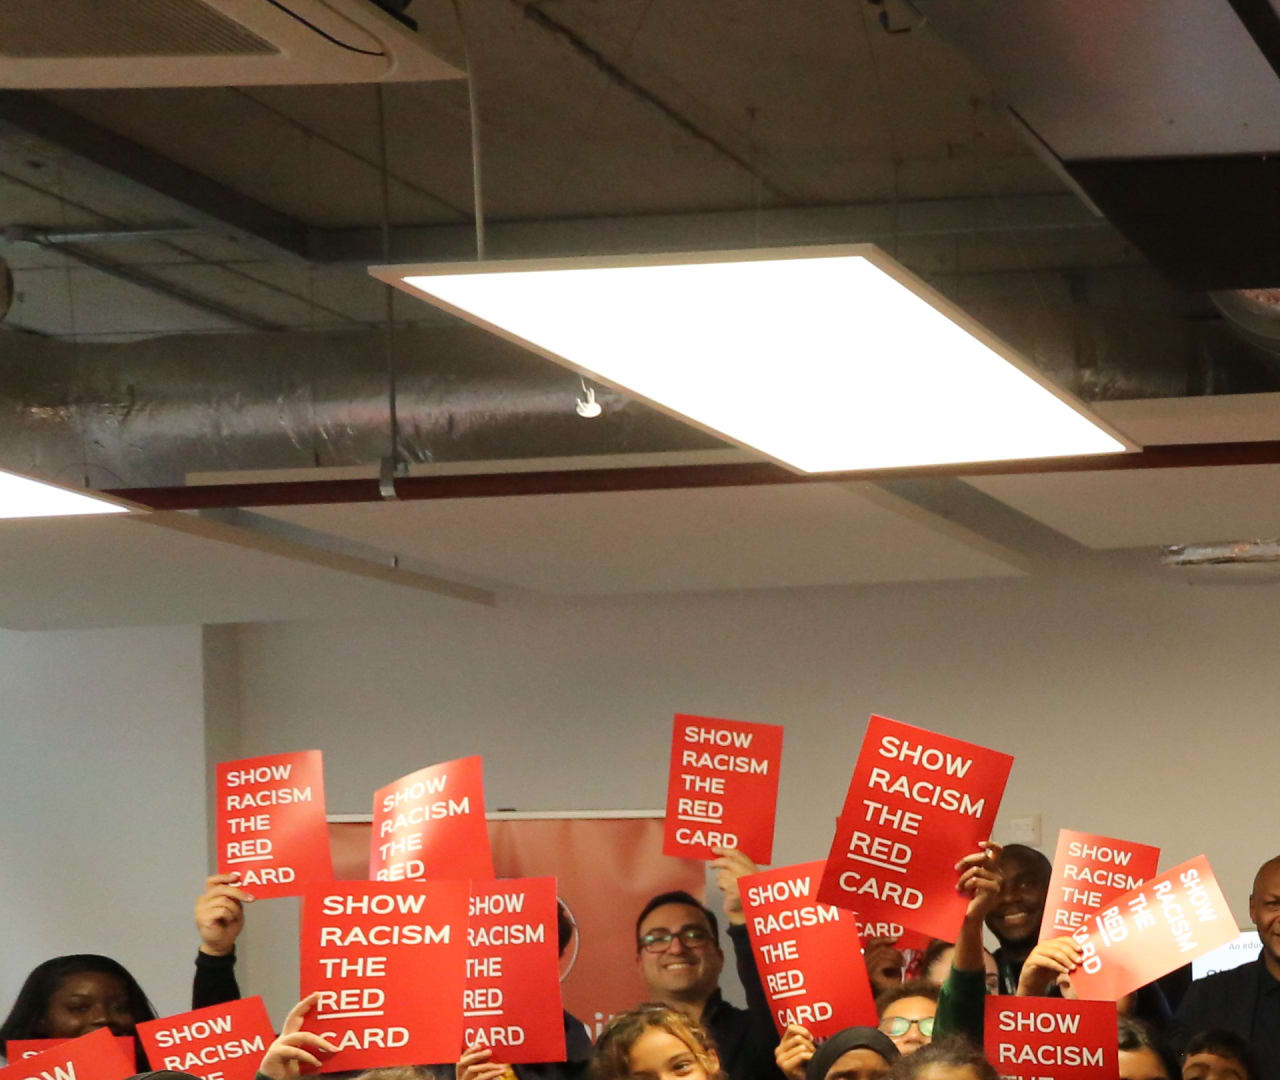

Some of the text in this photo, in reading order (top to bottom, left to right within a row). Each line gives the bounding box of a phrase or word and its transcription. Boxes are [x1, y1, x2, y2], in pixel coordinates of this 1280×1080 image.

[685, 727, 752, 748] SHOW
[683, 751, 768, 775] RACISM
[879, 736, 972, 778] SHOW
[227, 765, 291, 787] SHOW
[682, 774, 725, 794] THE
[227, 787, 312, 811] RACISM
[864, 768, 984, 821] RACISM
[678, 799, 723, 817] RED
[864, 800, 922, 834] THE
[227, 815, 270, 833] THE
[227, 839, 272, 858] RED
[676, 828, 737, 854] CARD
[850, 831, 911, 864] RED
[749, 877, 810, 906] SHOW
[840, 872, 923, 909] CARD
[323, 895, 426, 915] SHOW
[754, 905, 839, 935] RACISM
[321, 925, 450, 946] RACISM
[760, 940, 798, 963] THE
[320, 957, 386, 978] THE
[767, 970, 804, 992] RED
[318, 990, 384, 1012] RED
